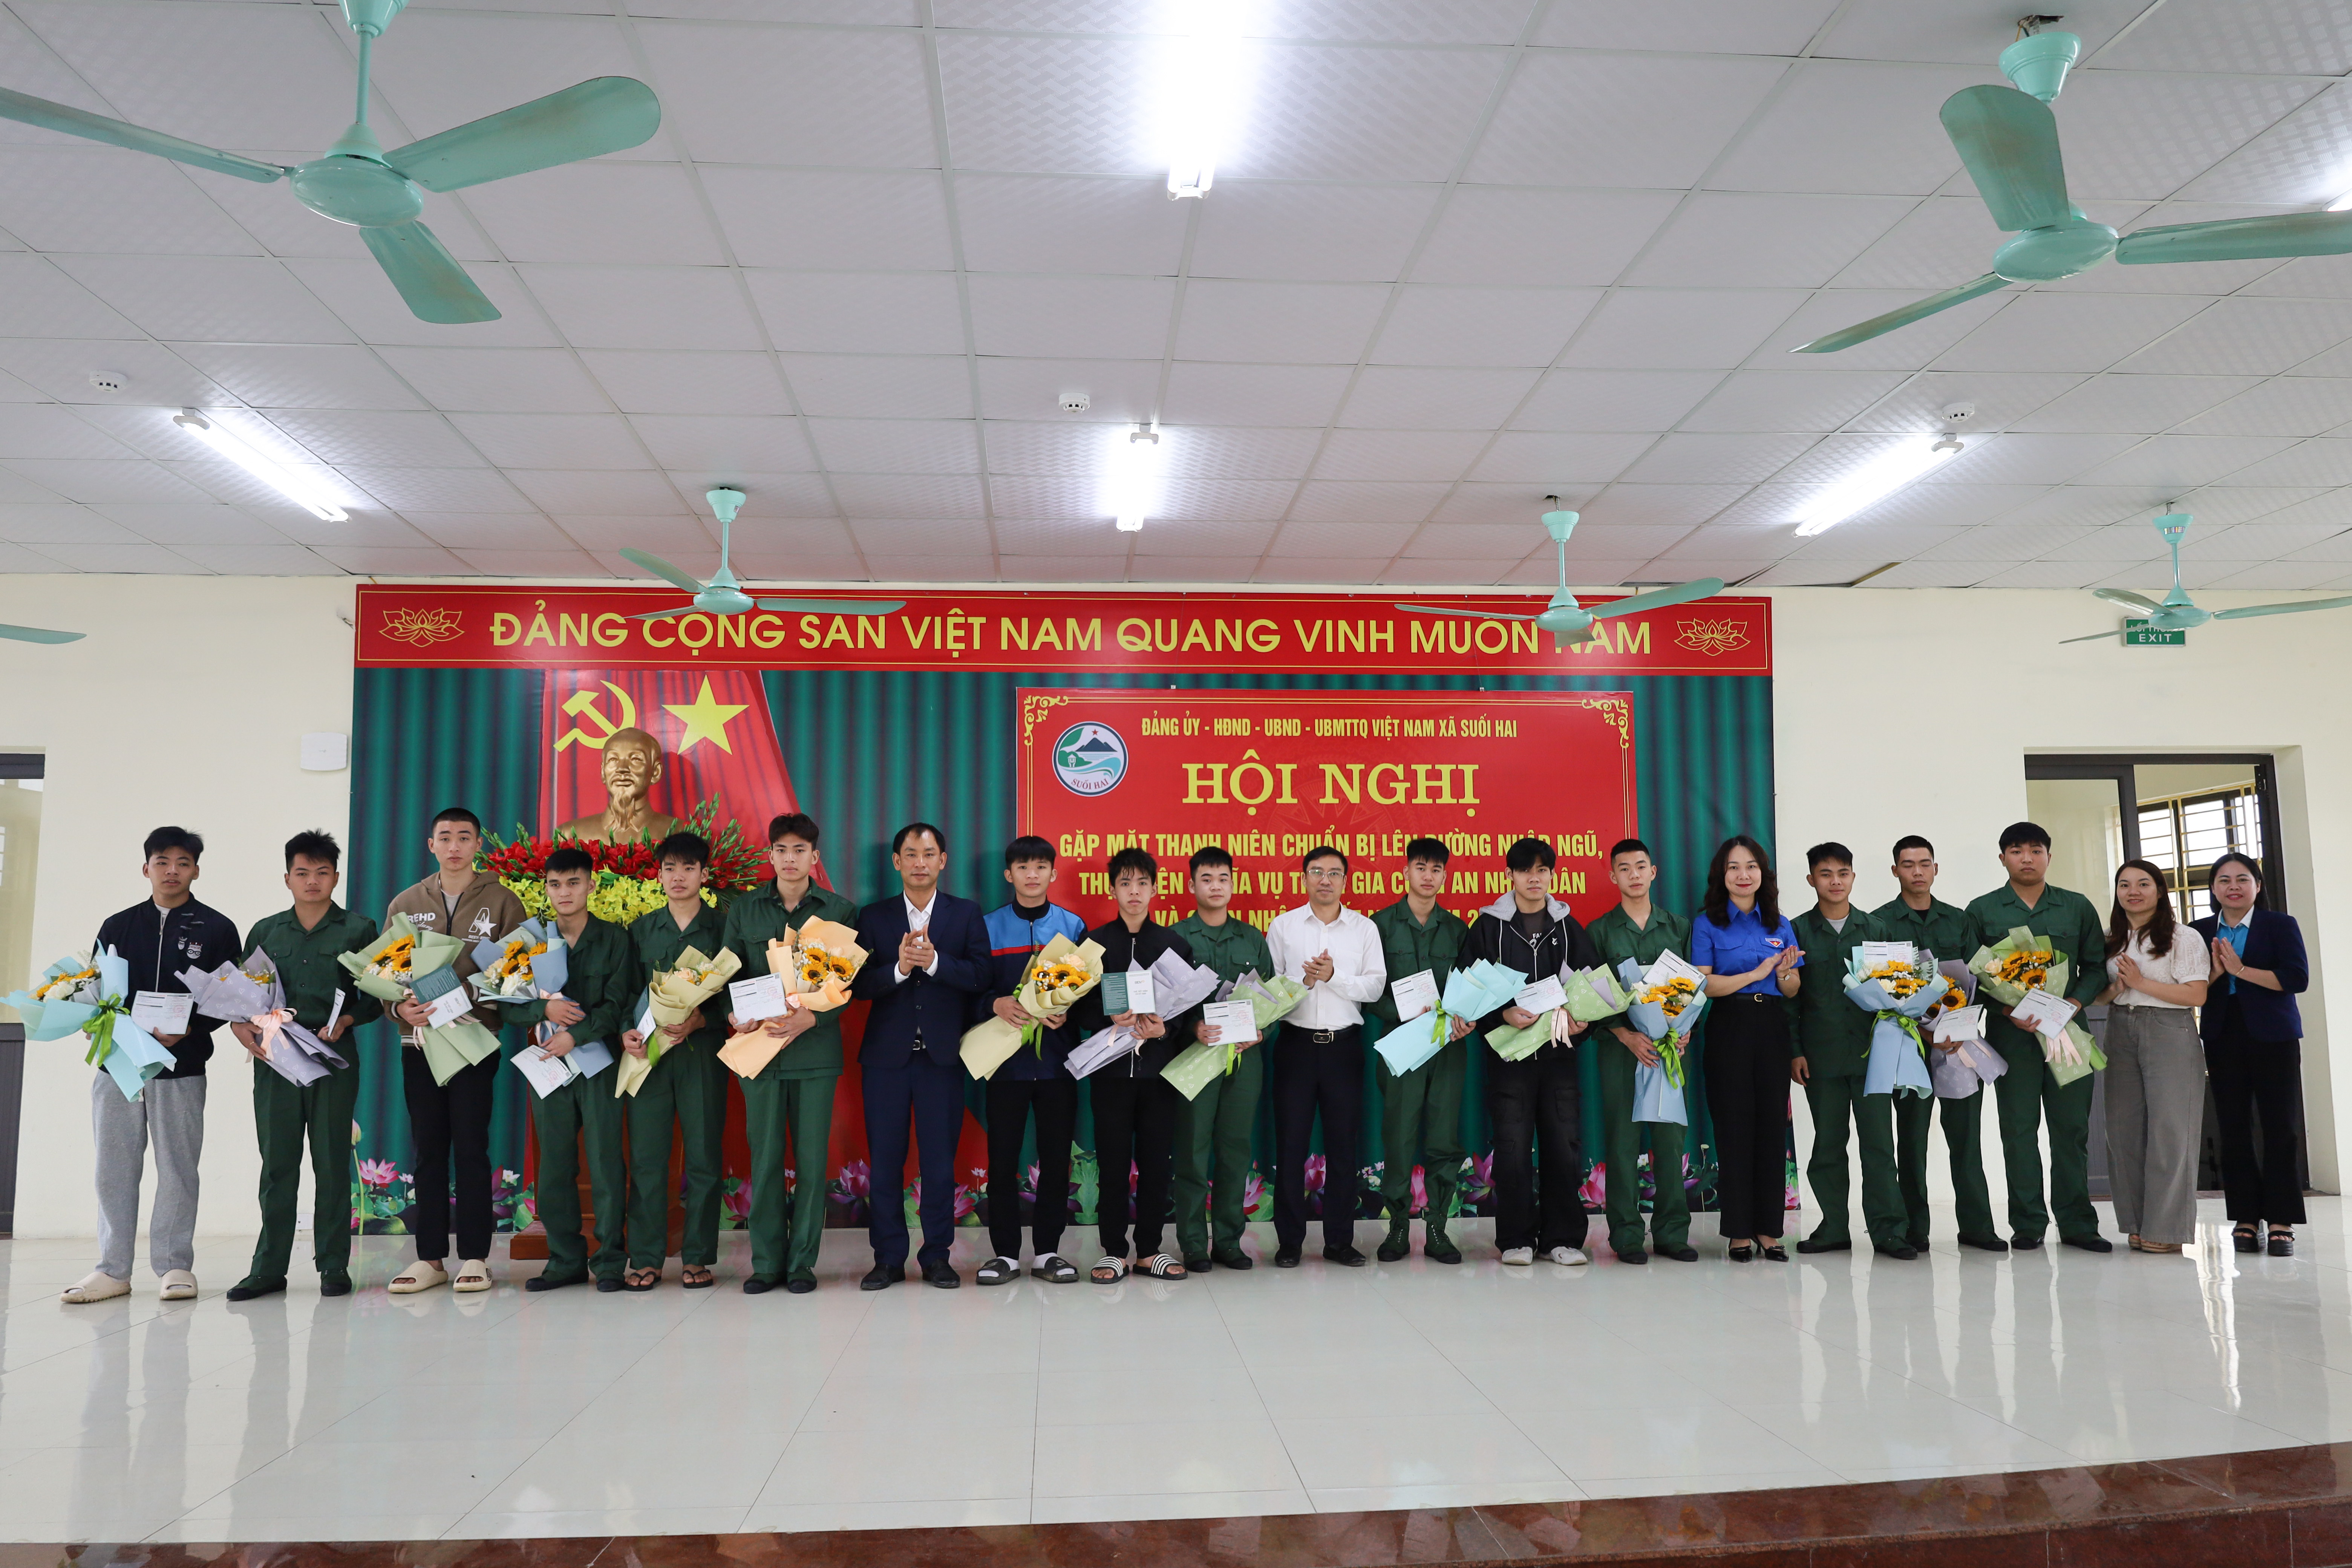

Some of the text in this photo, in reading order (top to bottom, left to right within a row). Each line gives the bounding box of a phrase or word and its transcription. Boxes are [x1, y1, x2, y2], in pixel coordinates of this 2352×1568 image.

[490, 600, 628, 647] ĐẢNG
[901, 608, 986, 658] VIỆT
[1001, 617, 1102, 651] NAM
[1117, 618, 1280, 653] QUANG
[1293, 620, 1394, 653] VINH
[1142, 710, 1179, 736] ĐẢNG
[1183, 710, 1200, 736] ỦY
[1214, 718, 1251, 736] HĐND
[1265, 719, 1301, 736] UBND
[1315, 719, 1368, 738] UBMTTQ
[1372, 716, 1400, 741] VIỆT
[1404, 720, 1435, 737] NAM
[1439, 716, 1456, 737] XÃ
[1461, 713, 1491, 737] SUỐI
[1495, 720, 1517, 737] HAI
[1071, 778, 1109, 790] SUỐI HAI
[1182, 749, 1480, 817] HỘI NGHỊ
[1060, 829, 1099, 862] GẶP
[1156, 834, 1221, 856] THANH
[1228, 830, 1276, 856] NIÊN
[1282, 825, 1349, 856] CHUẨN
[1357, 835, 1375, 861] BỊ
[1558, 831, 1603, 859] NGŨ,
[1258, 872, 1283, 899] VỤ
[1352, 872, 1385, 894] GIA
[1452, 872, 1478, 893] AN
